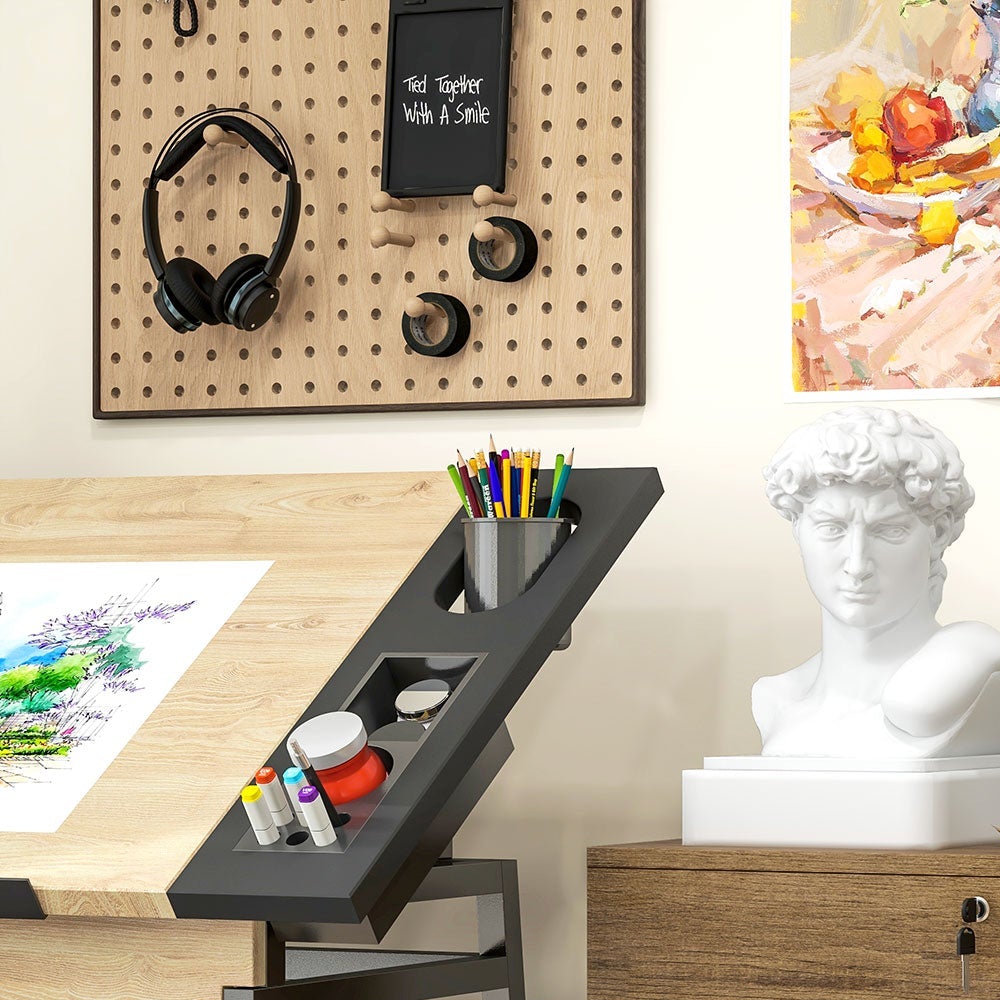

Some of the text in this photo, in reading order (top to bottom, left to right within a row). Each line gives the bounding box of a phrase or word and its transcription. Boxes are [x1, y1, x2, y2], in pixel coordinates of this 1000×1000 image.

[403, 74, 483, 103] Tied Together
[402, 100, 490, 125] With A Smile
